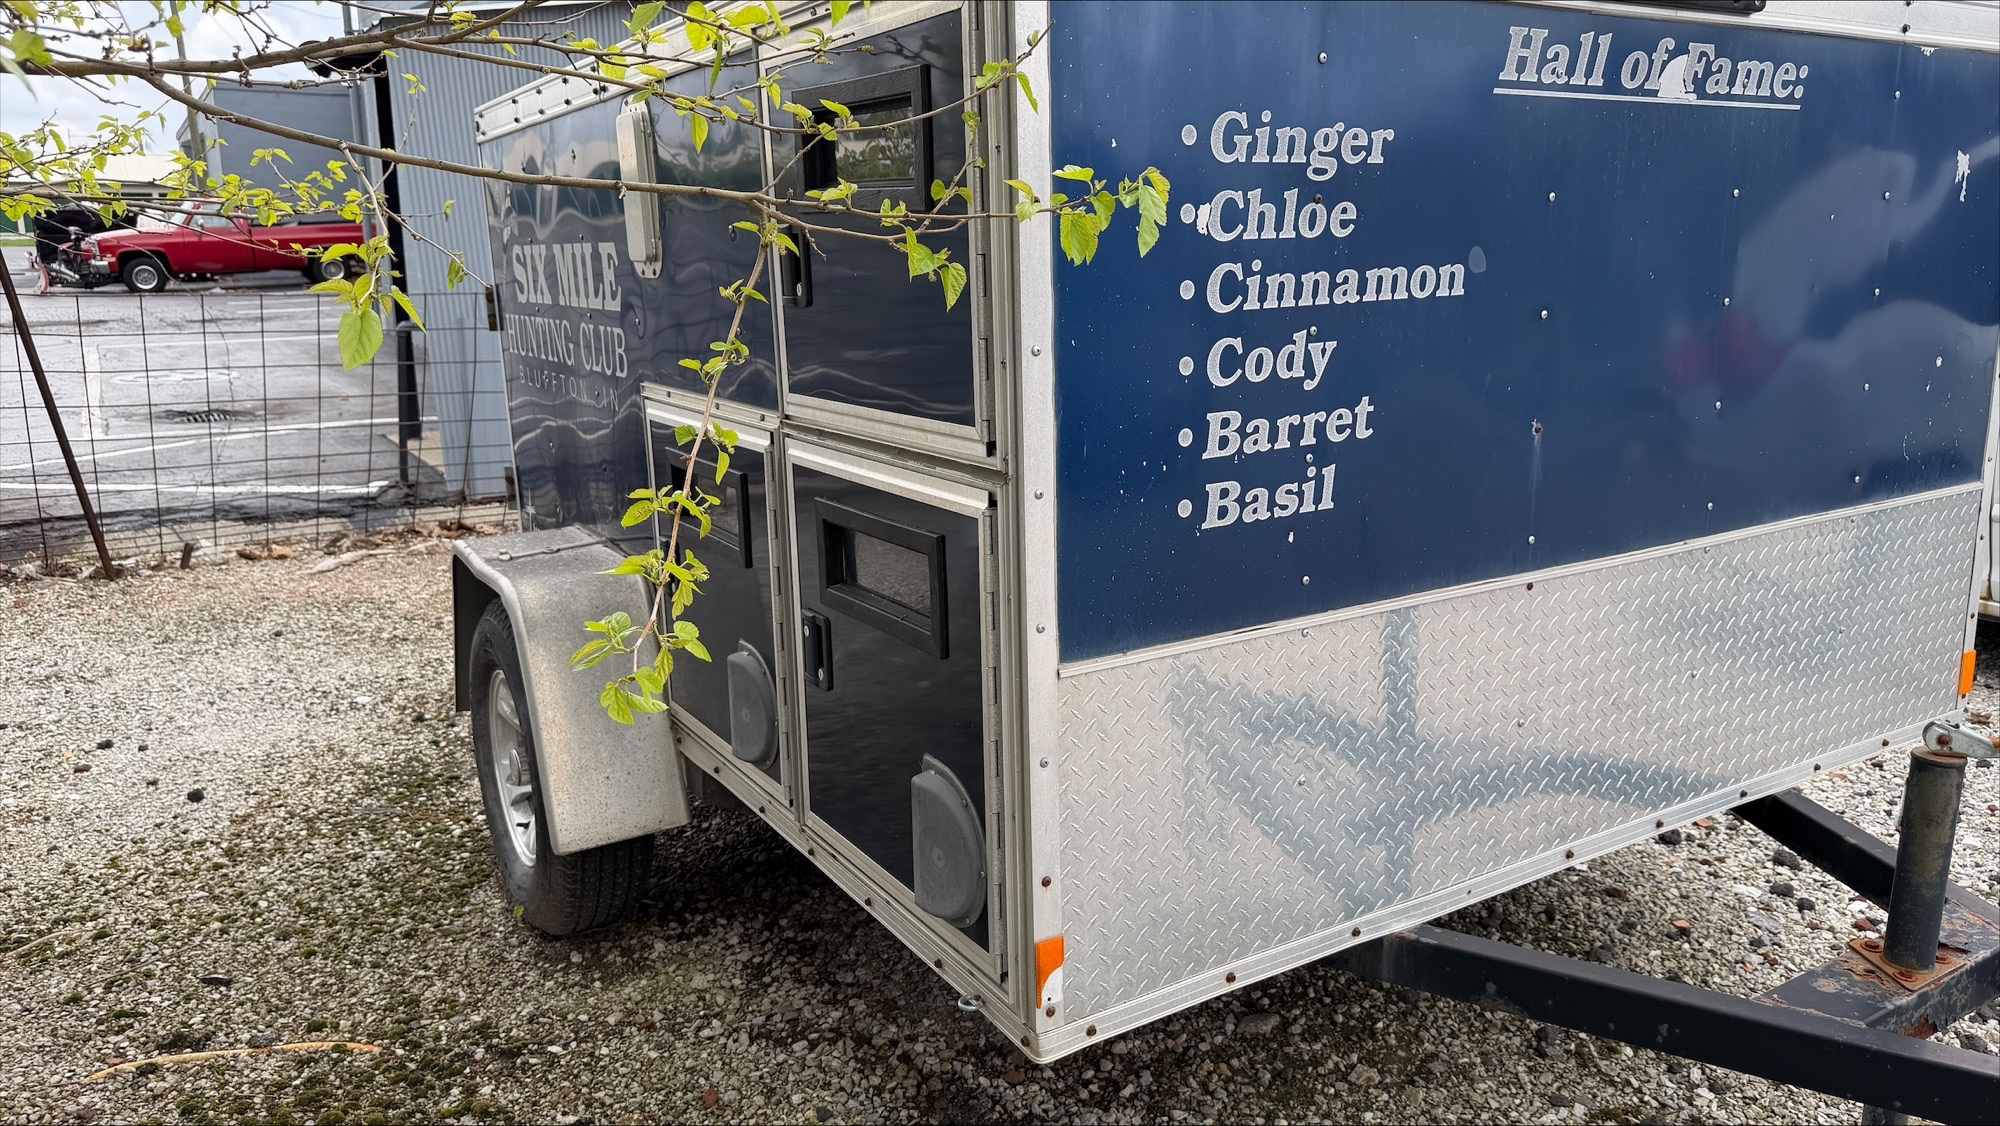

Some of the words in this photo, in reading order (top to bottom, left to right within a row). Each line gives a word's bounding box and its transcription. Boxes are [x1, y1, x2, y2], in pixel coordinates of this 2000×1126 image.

[1499, 26, 1612, 86] Hall
[1620, 37, 1676, 90] of
[1683, 42, 1808, 99] Fame:
[1210, 110, 1394, 181] Ginger
[1207, 188, 1357, 242] Chloe
[512, 244, 552, 304] SIX
[553, 242, 622, 312] MILE
[1206, 259, 1465, 314] Cinnamon
[506, 313, 575, 366] HUNTING
[579, 321, 628, 378] CLUB
[1206, 329, 1338, 390] Cody
[602, 386, 619, 411] IN
[1202, 396, 1375, 460] Barret
[1201, 464, 1336, 530] Basil
